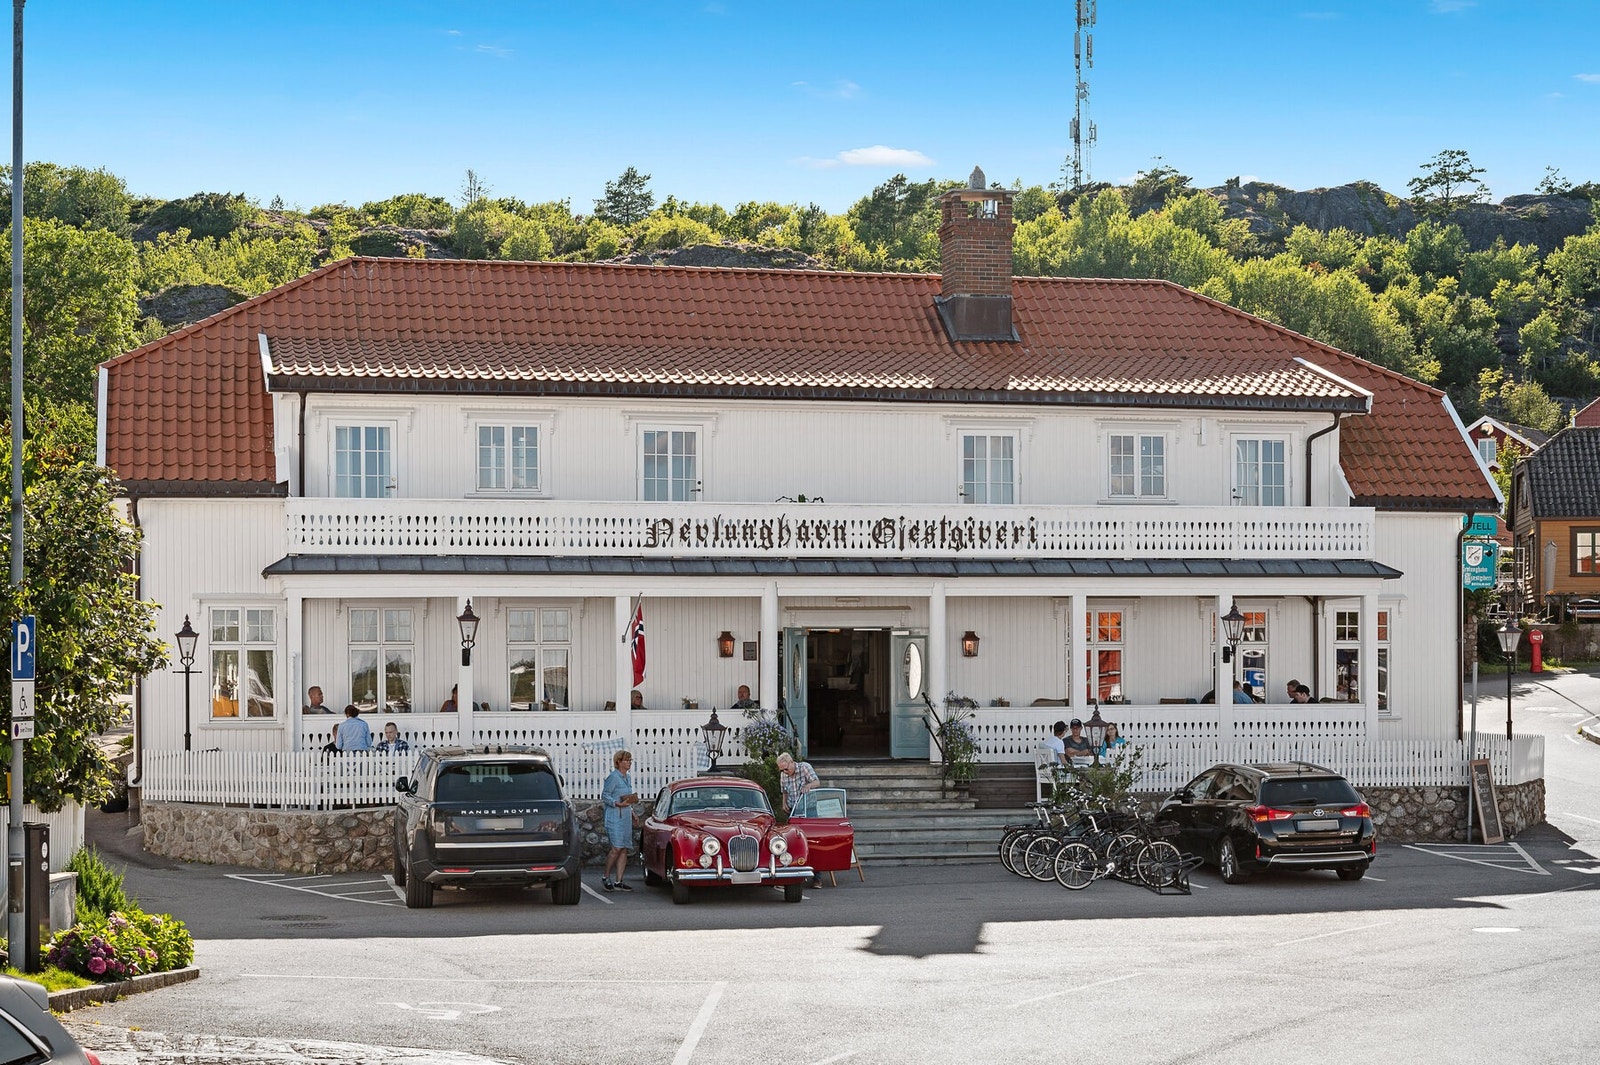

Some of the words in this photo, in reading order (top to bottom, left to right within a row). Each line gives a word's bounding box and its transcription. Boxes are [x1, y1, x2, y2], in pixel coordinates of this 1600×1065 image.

[643, 513, 846, 550] Nevlunghavn
[872, 515, 1038, 552] Gjestgiveri
[17, 623, 30, 671] P
